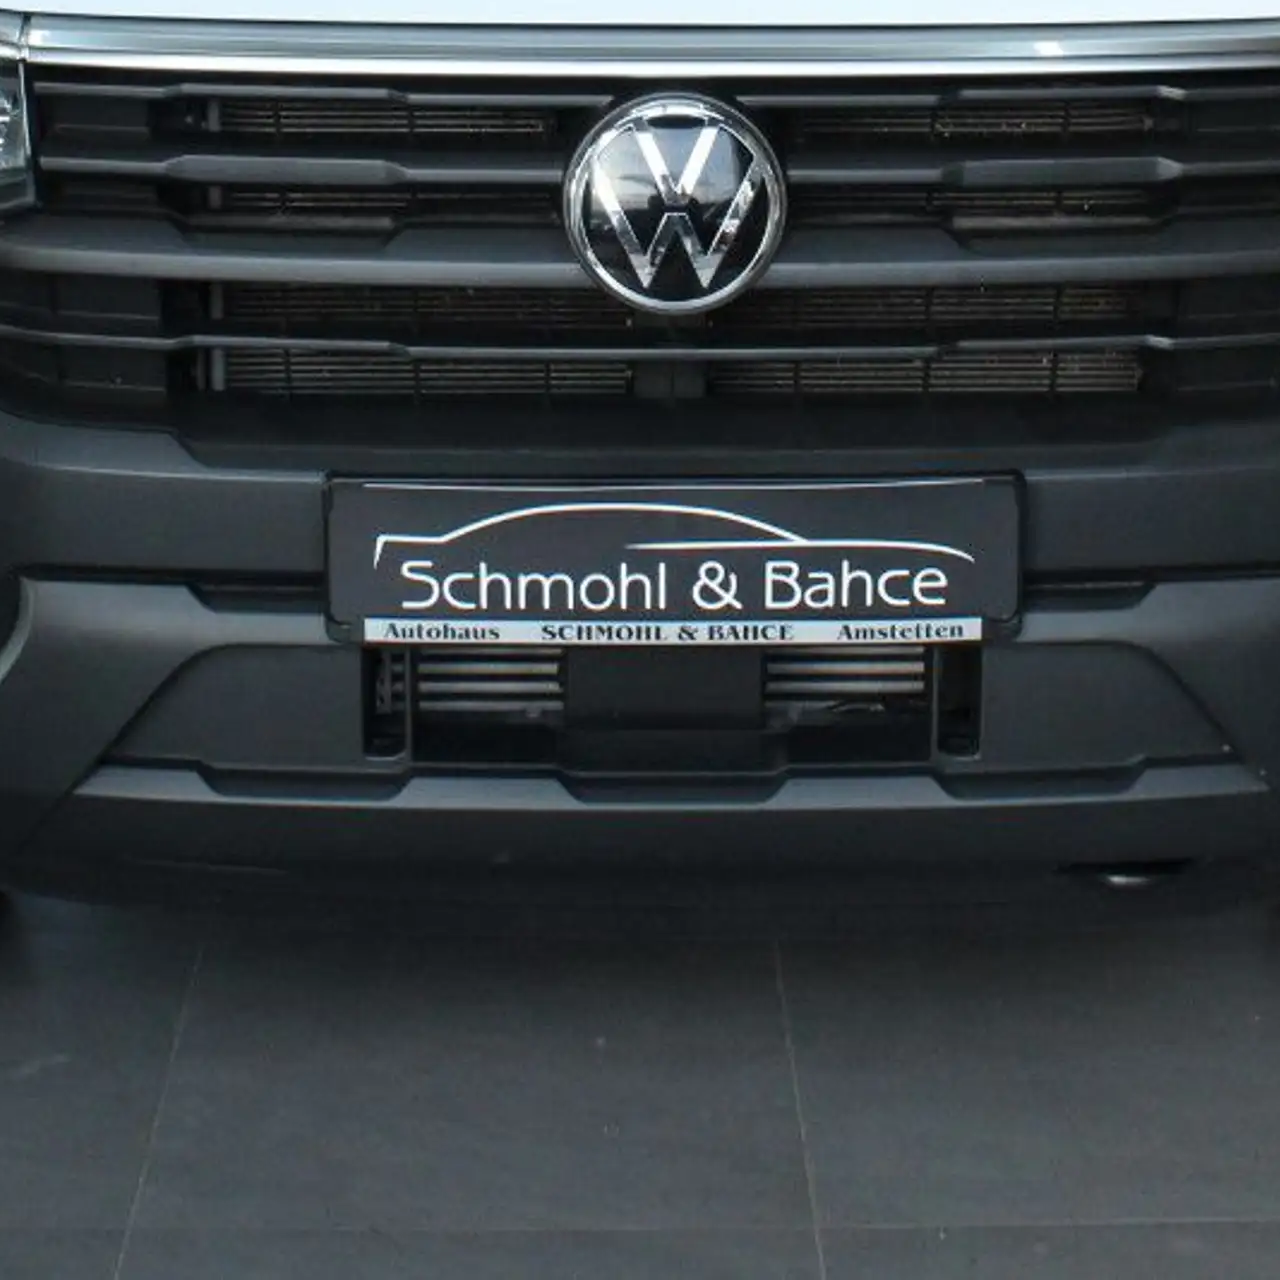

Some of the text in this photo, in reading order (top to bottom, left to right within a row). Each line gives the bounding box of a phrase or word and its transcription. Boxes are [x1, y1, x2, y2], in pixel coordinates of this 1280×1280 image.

[576, 106, 772, 300] VW
[400, 558, 949, 611] Schmohl & Bahce
[384, 622, 964, 641] Autohaus SCHMOHL & BAHCE Amstetten
